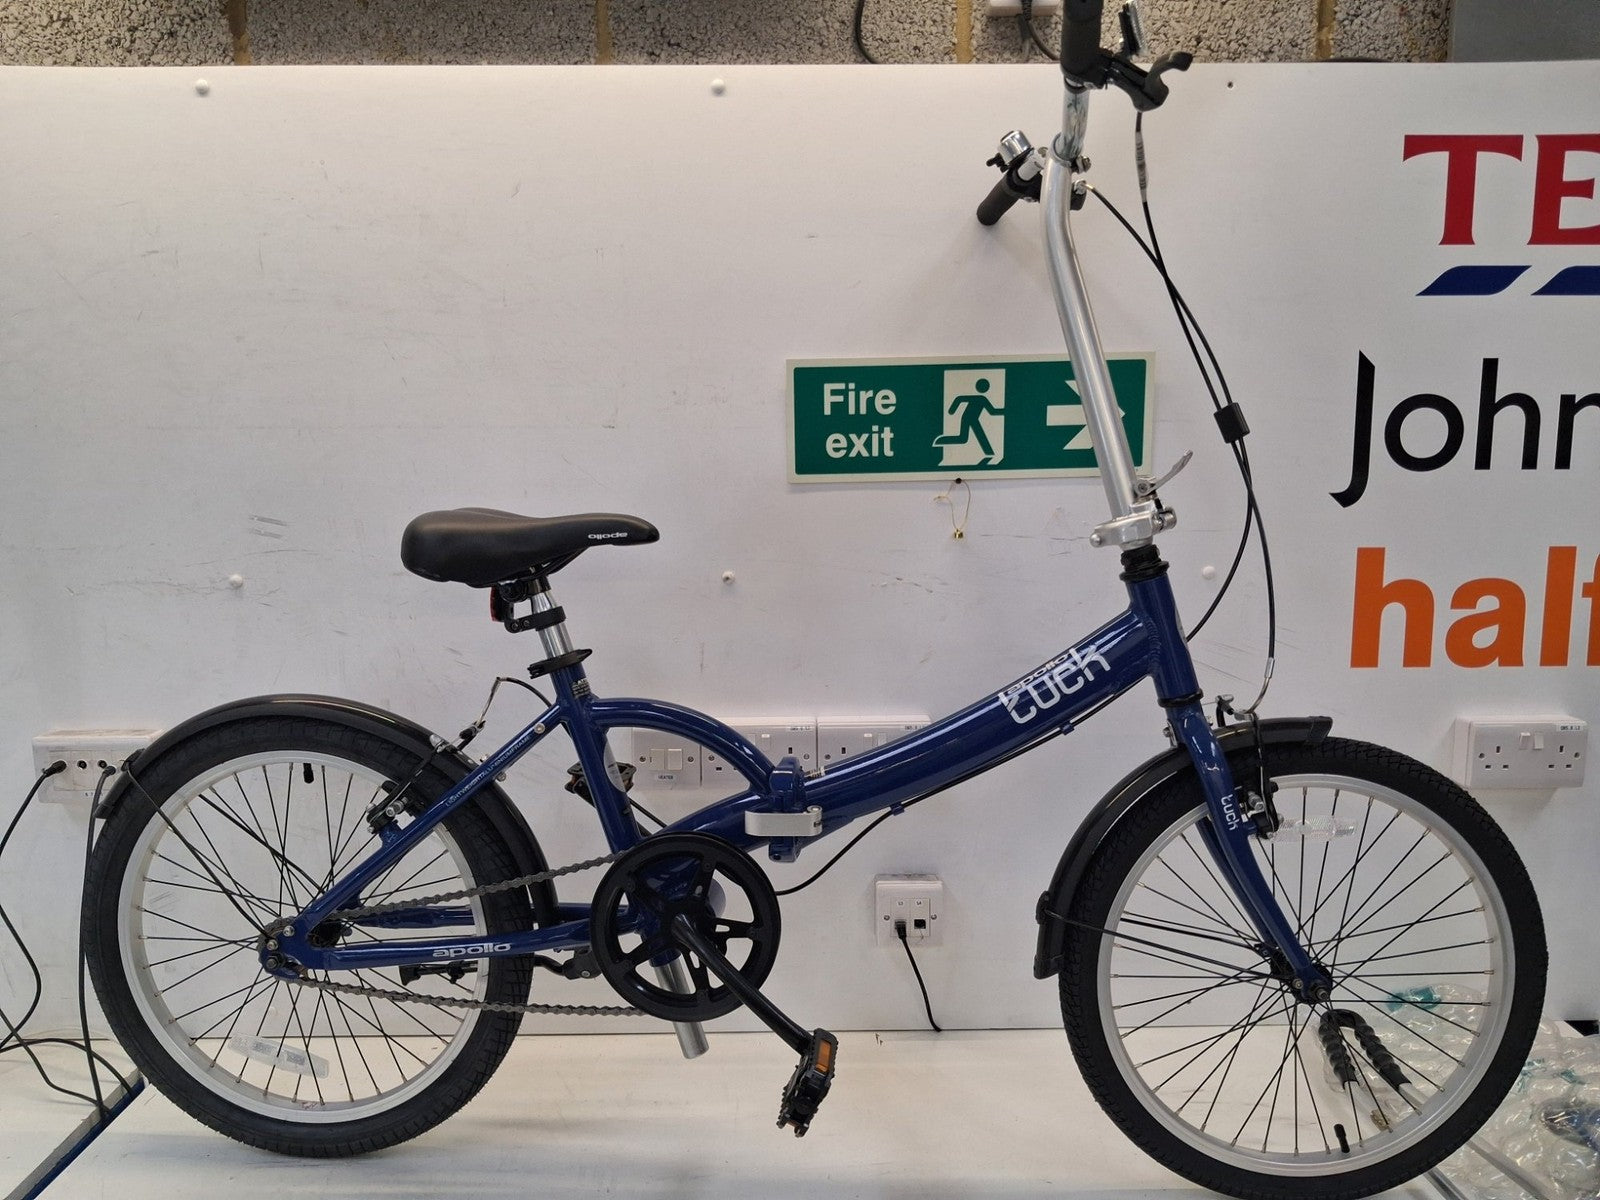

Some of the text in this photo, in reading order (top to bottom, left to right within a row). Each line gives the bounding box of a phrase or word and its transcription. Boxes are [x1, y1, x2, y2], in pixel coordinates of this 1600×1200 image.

[1403, 134, 1600, 245] TE
[823, 382, 897, 415] Fire
[825, 425, 894, 458] exit
[588, 532, 628, 540] apollo
[1007, 652, 1069, 695] apollo
[1221, 793, 1240, 831] tuck
[432, 942, 512, 958] apollo
